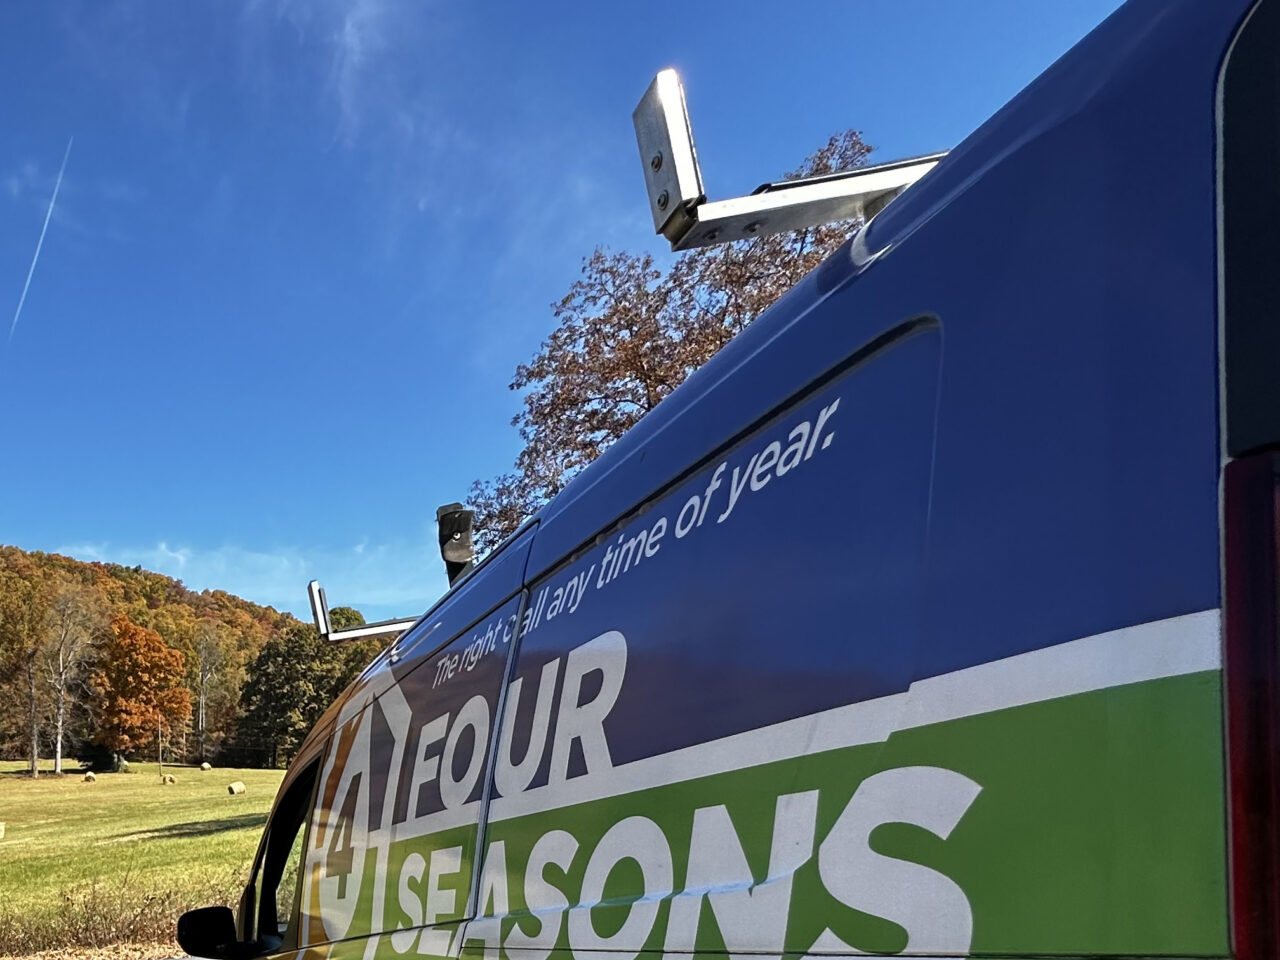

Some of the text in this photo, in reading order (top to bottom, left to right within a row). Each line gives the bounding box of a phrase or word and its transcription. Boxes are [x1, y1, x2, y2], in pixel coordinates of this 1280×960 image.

[432, 652, 458, 690] The
[458, 617, 503, 673] right
[546, 563, 595, 614] any
[596, 516, 668, 590] time
[674, 461, 727, 539] of
[717, 396, 841, 524] year.
[410, 629, 628, 827] FOUR
